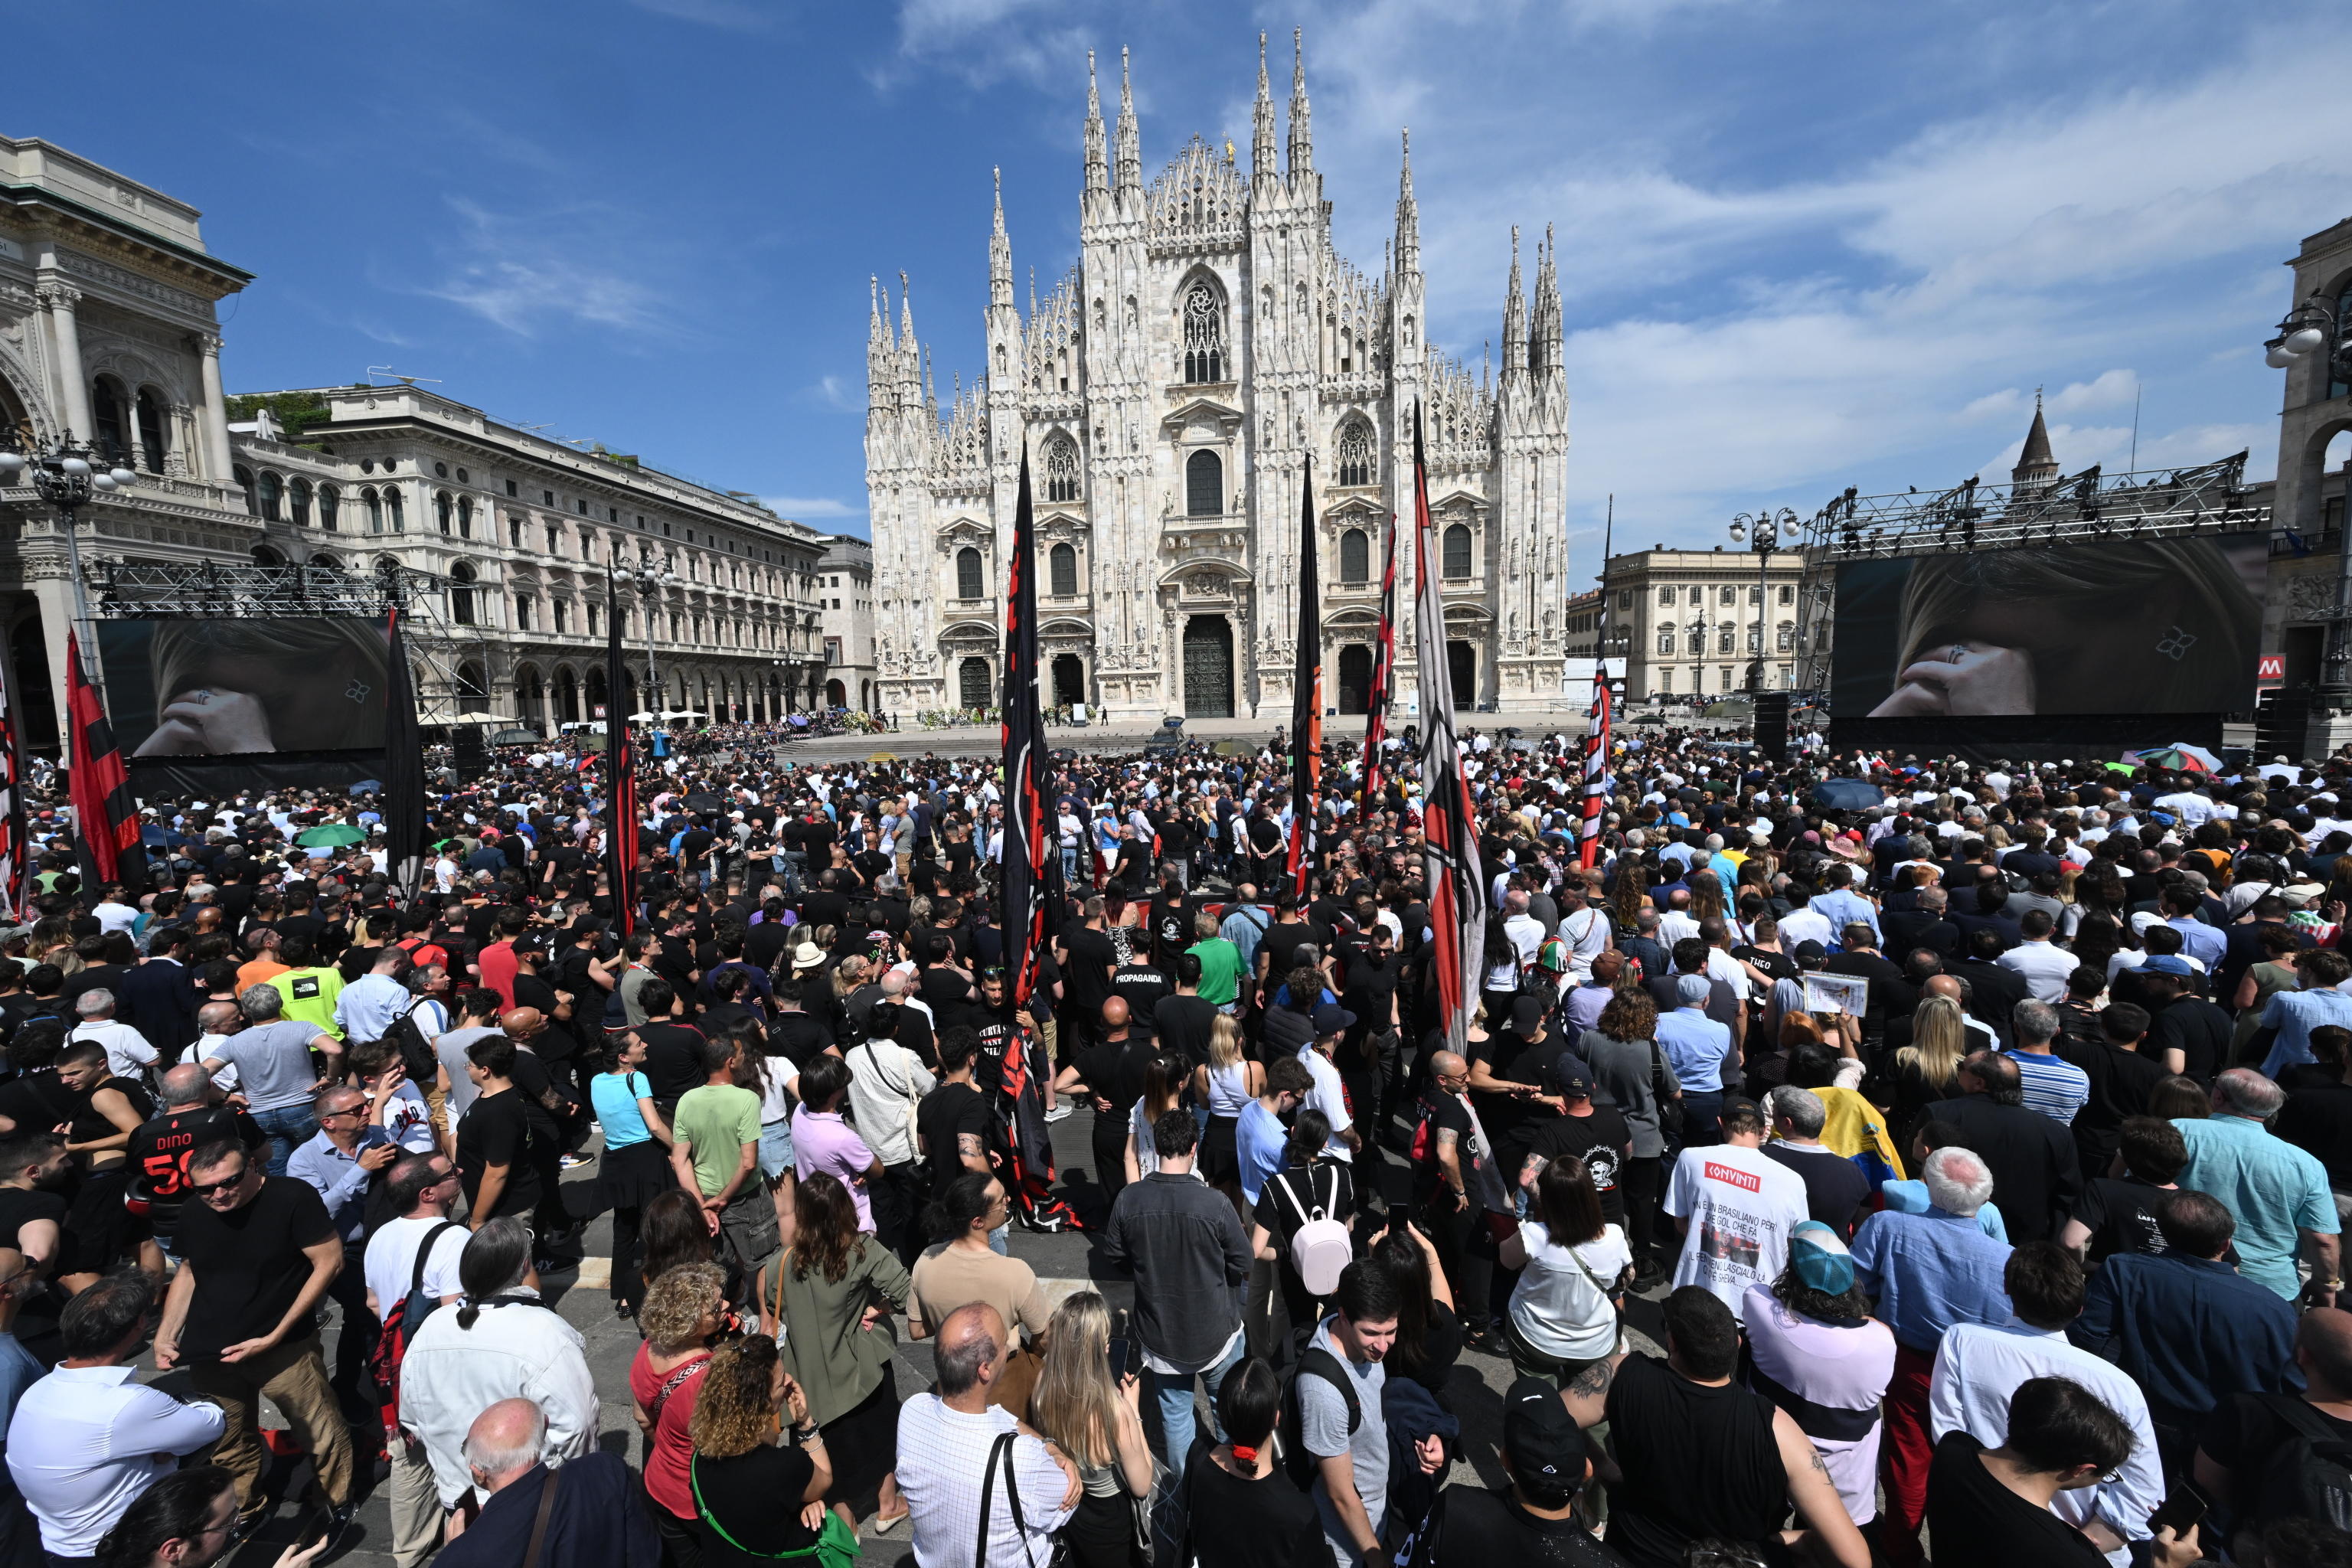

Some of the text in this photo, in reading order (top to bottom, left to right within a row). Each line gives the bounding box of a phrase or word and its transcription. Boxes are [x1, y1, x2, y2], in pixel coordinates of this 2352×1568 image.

[2258, 659, 2282, 675] M
[595, 707, 606, 716] M
[1749, 956, 1771, 969] THEO
[1116, 974, 1162, 984] PROPAGANDA
[979, 1024, 1001, 1037] CURVA
[157, 1132, 192, 1150] DINO
[1709, 1165, 1757, 1190] CONVINTI
[1705, 1212, 1716, 1224] CHE
[1717, 1216, 1730, 1228] GOL
[1732, 1220, 1747, 1233] CHE
[1717, 1204, 1759, 1226] BRASILIANO
[1696, 1253, 1723, 1271] FENMENO
[1723, 1263, 1756, 1279] LASCIALO
